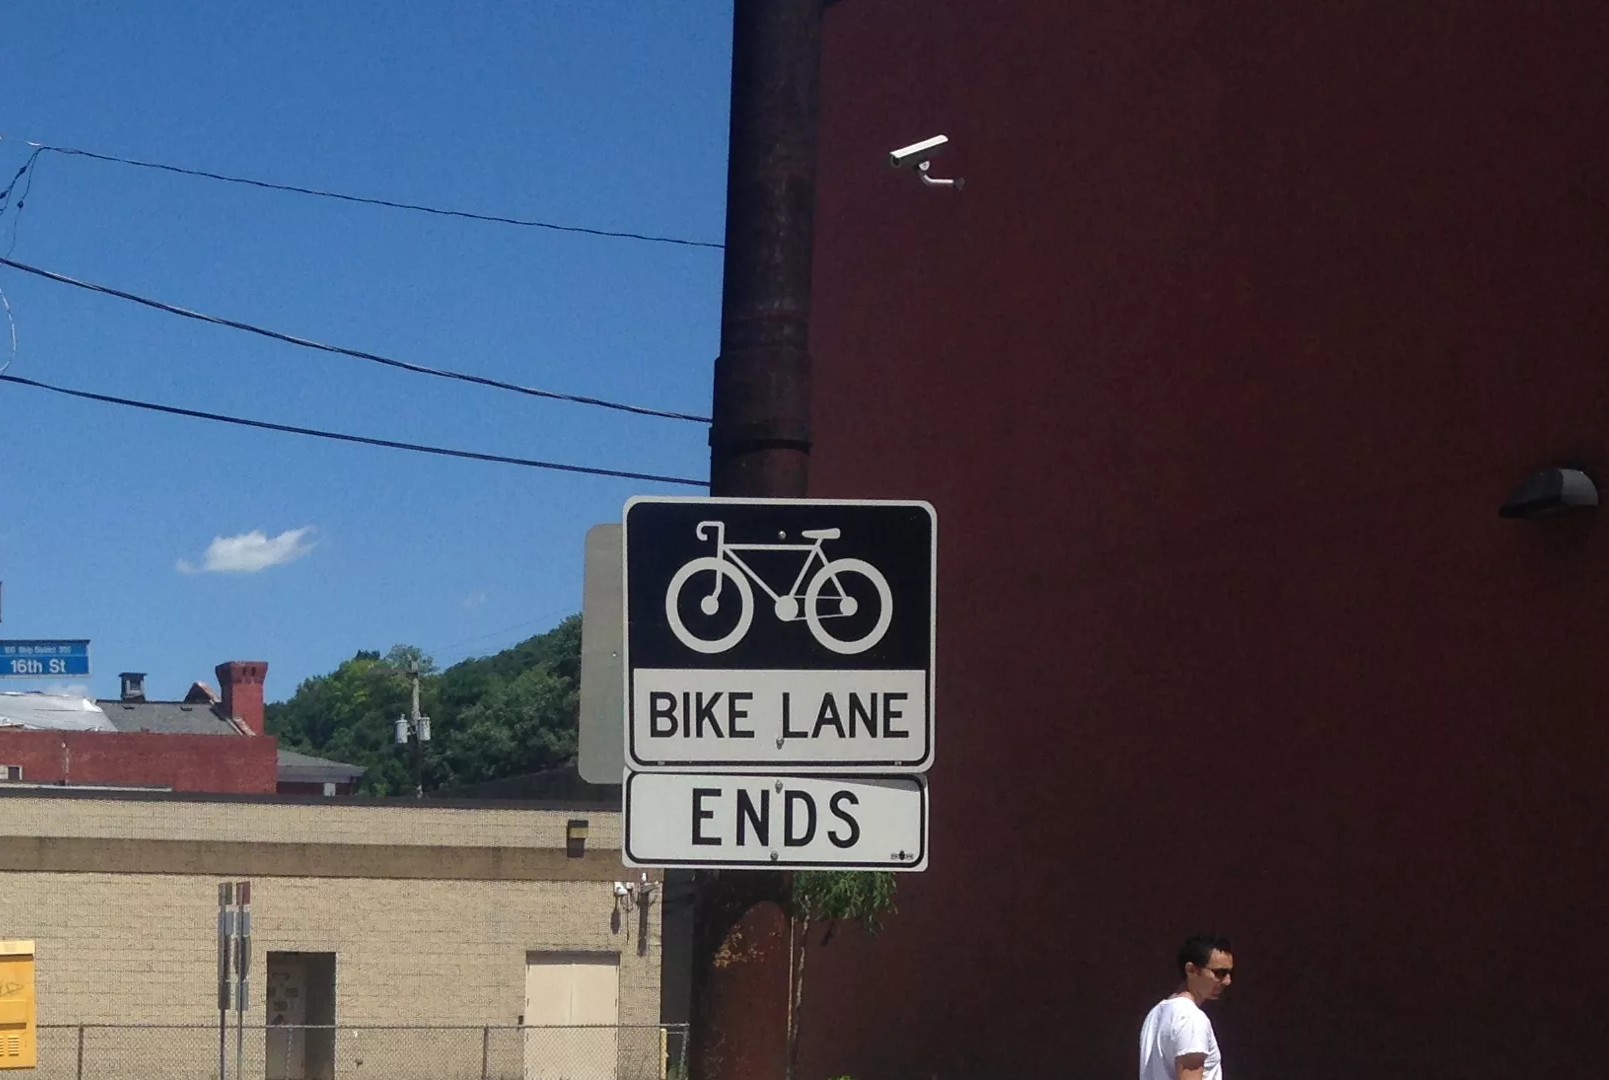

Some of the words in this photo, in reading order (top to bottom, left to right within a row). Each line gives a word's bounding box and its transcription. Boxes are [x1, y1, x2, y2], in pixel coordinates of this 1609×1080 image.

[10, 659, 43, 673] 16th
[48, 658, 66, 673] St
[649, 691, 755, 739] BIKE
[781, 691, 909, 739] LANE
[691, 787, 861, 849] ENDS
